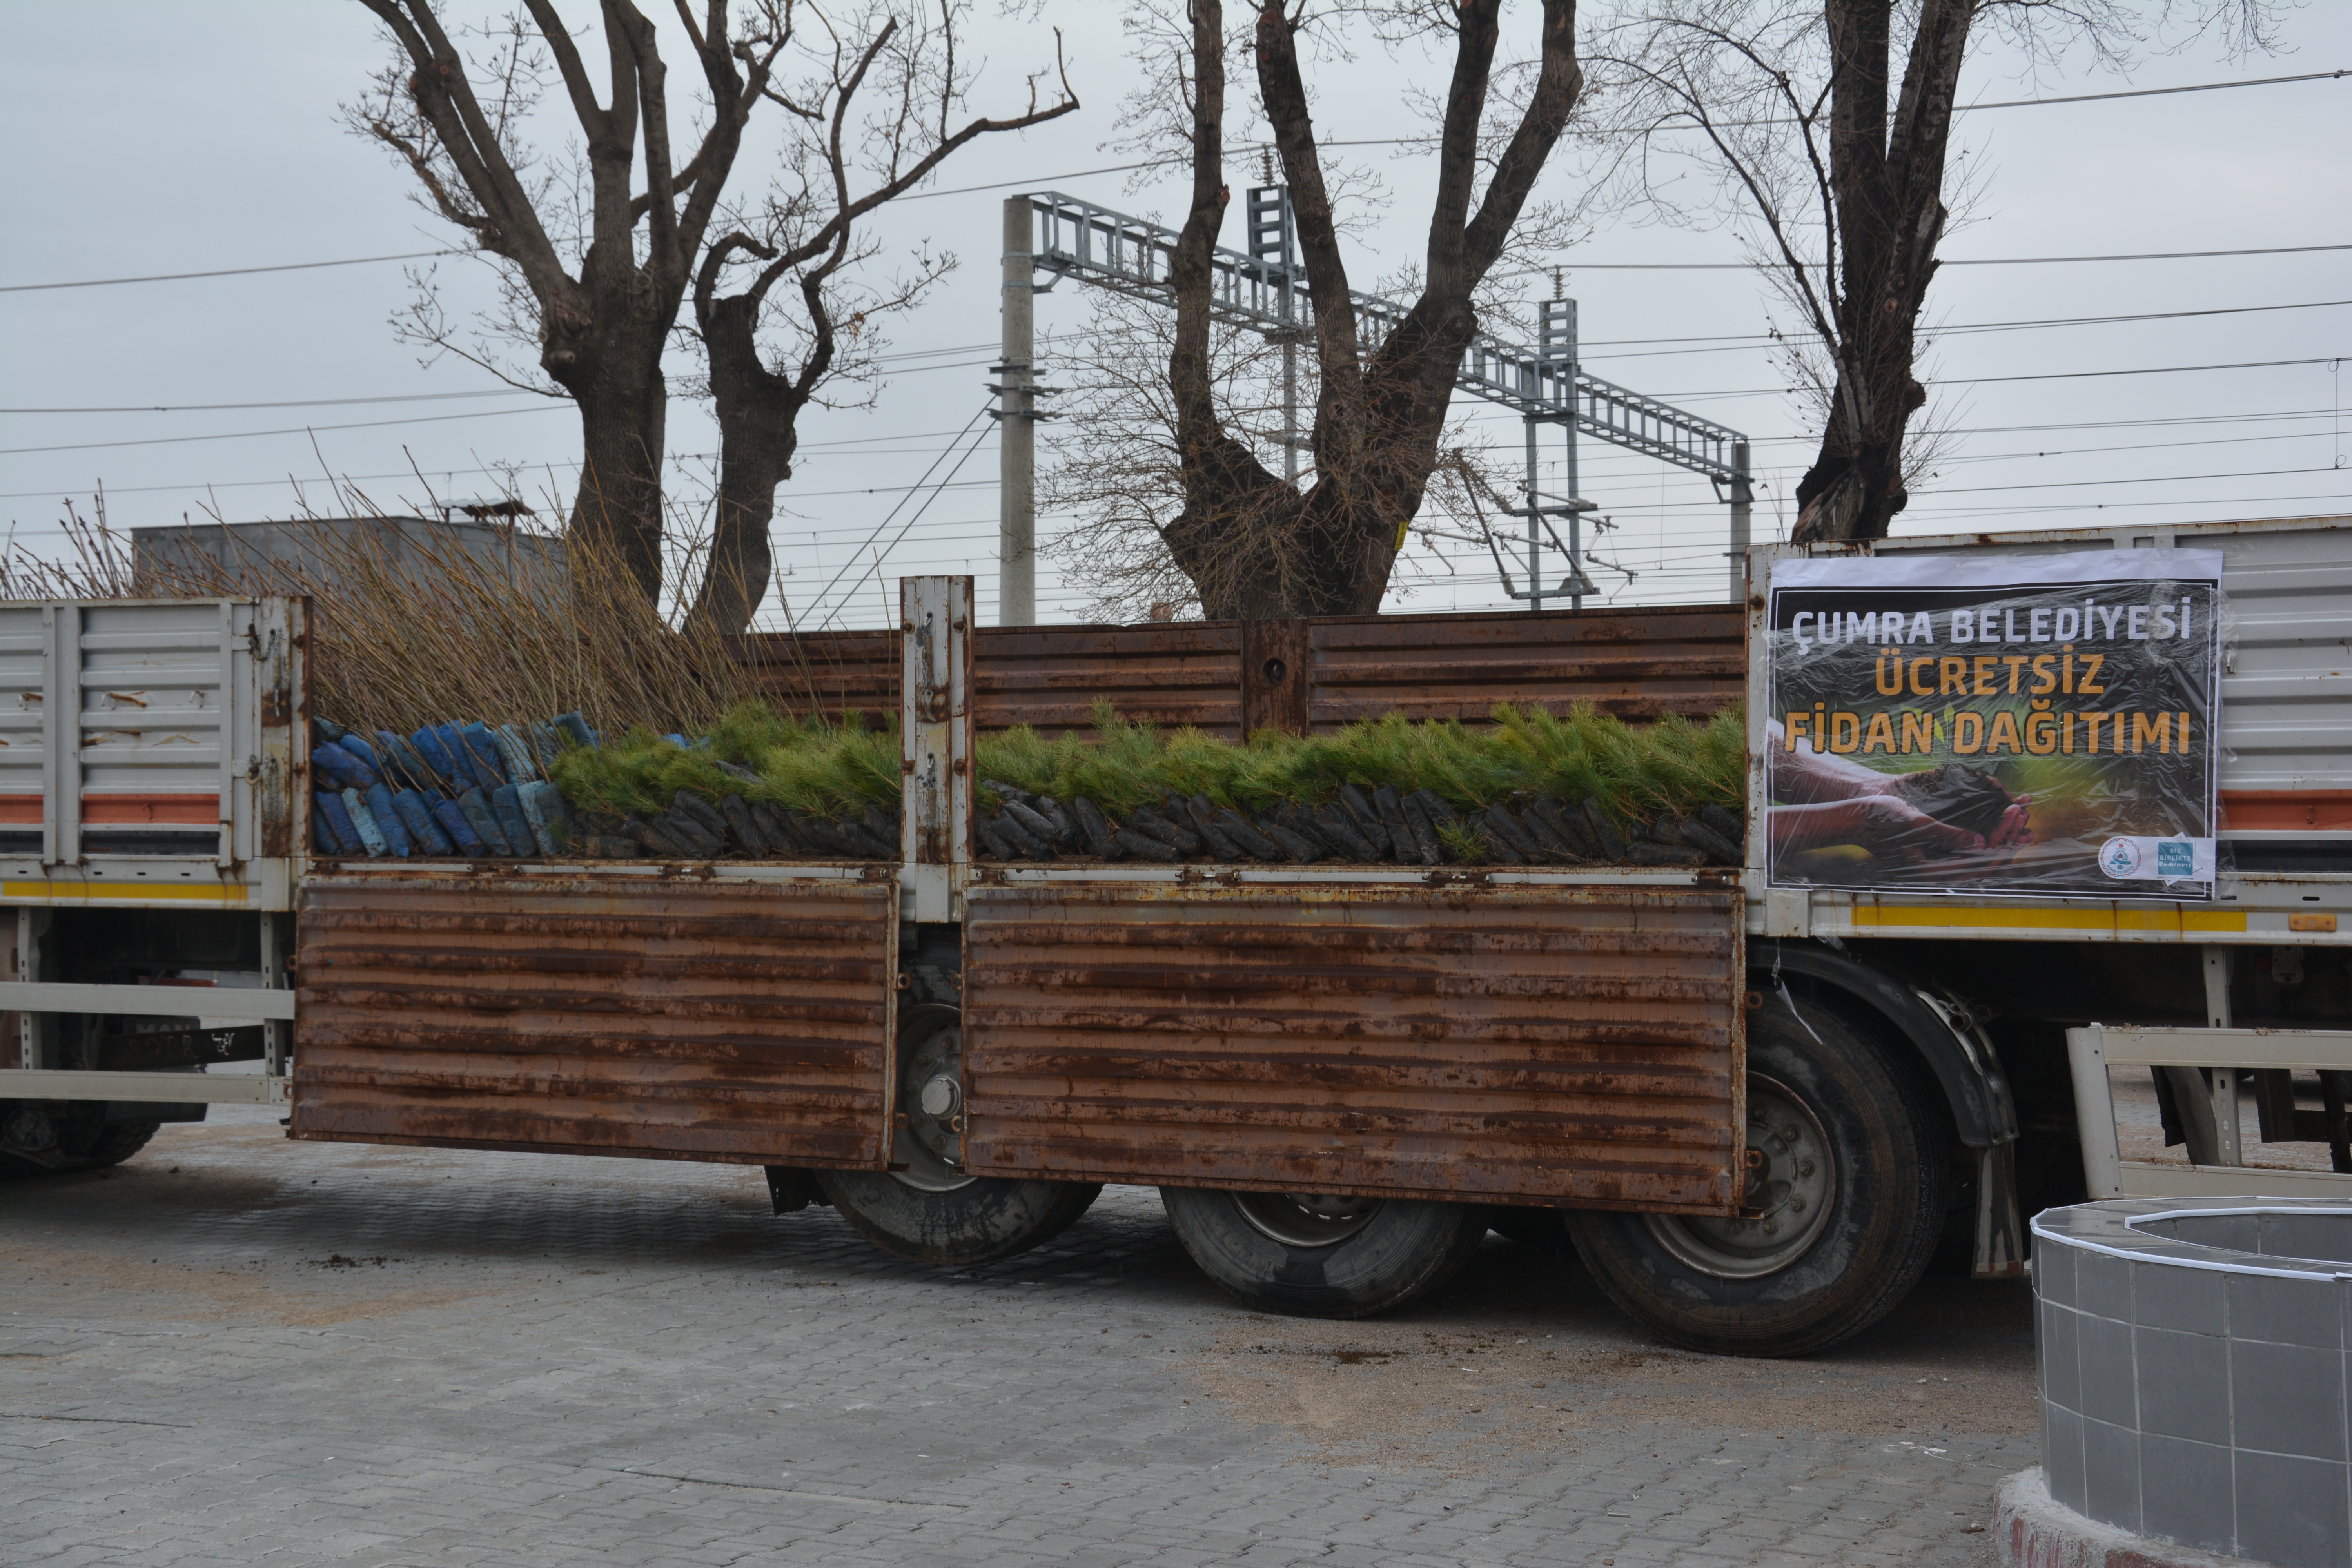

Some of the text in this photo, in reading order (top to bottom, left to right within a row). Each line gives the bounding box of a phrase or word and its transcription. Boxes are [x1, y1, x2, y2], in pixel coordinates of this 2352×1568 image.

[1792, 597, 2190, 655] ÇUMRA BELEDİYESİ
[1876, 645, 2104, 695] ÜCRETSİZ
[1784, 699, 2189, 754] FİDAN DAĞITIMI
